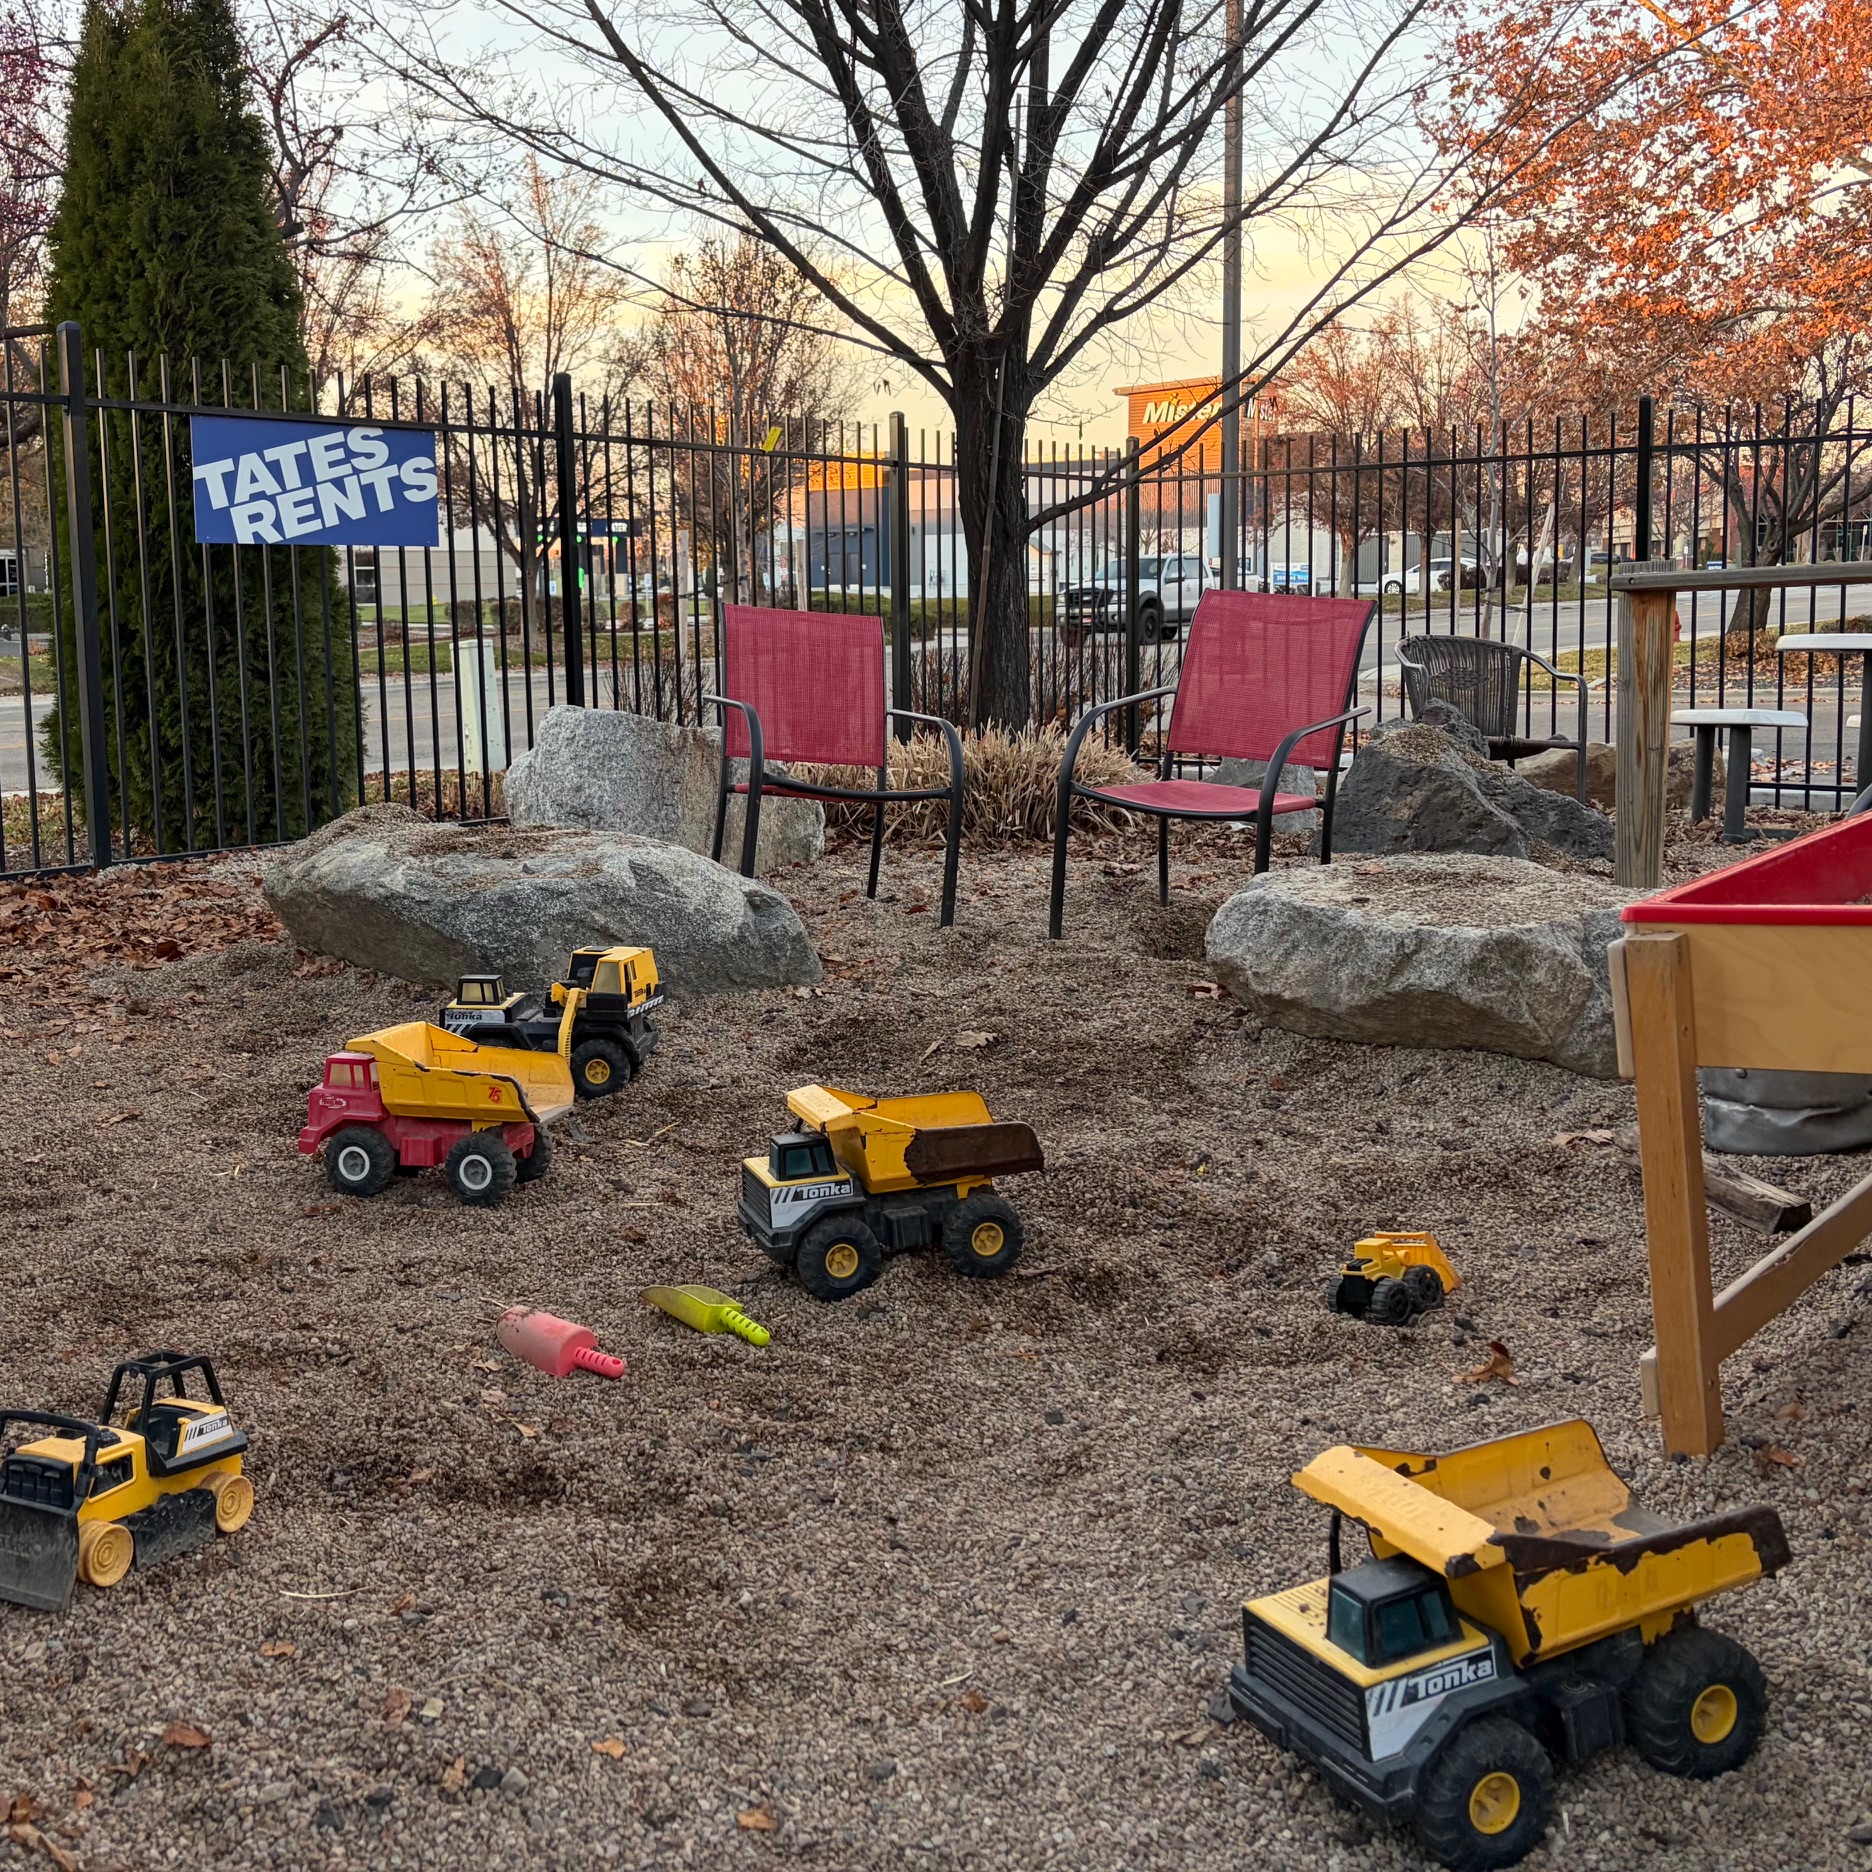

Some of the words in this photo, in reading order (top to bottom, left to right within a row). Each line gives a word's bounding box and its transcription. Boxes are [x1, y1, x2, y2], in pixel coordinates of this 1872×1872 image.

[193, 426, 389, 510] TATES
[230, 456, 438, 545] RENTS
[446, 1010, 483, 1021] Tonka
[488, 1086, 503, 1104] 75
[796, 1182, 851, 1200] Tonka
[200, 1418, 228, 1434] Tonka
[1408, 1658, 1492, 1700] Tonka
